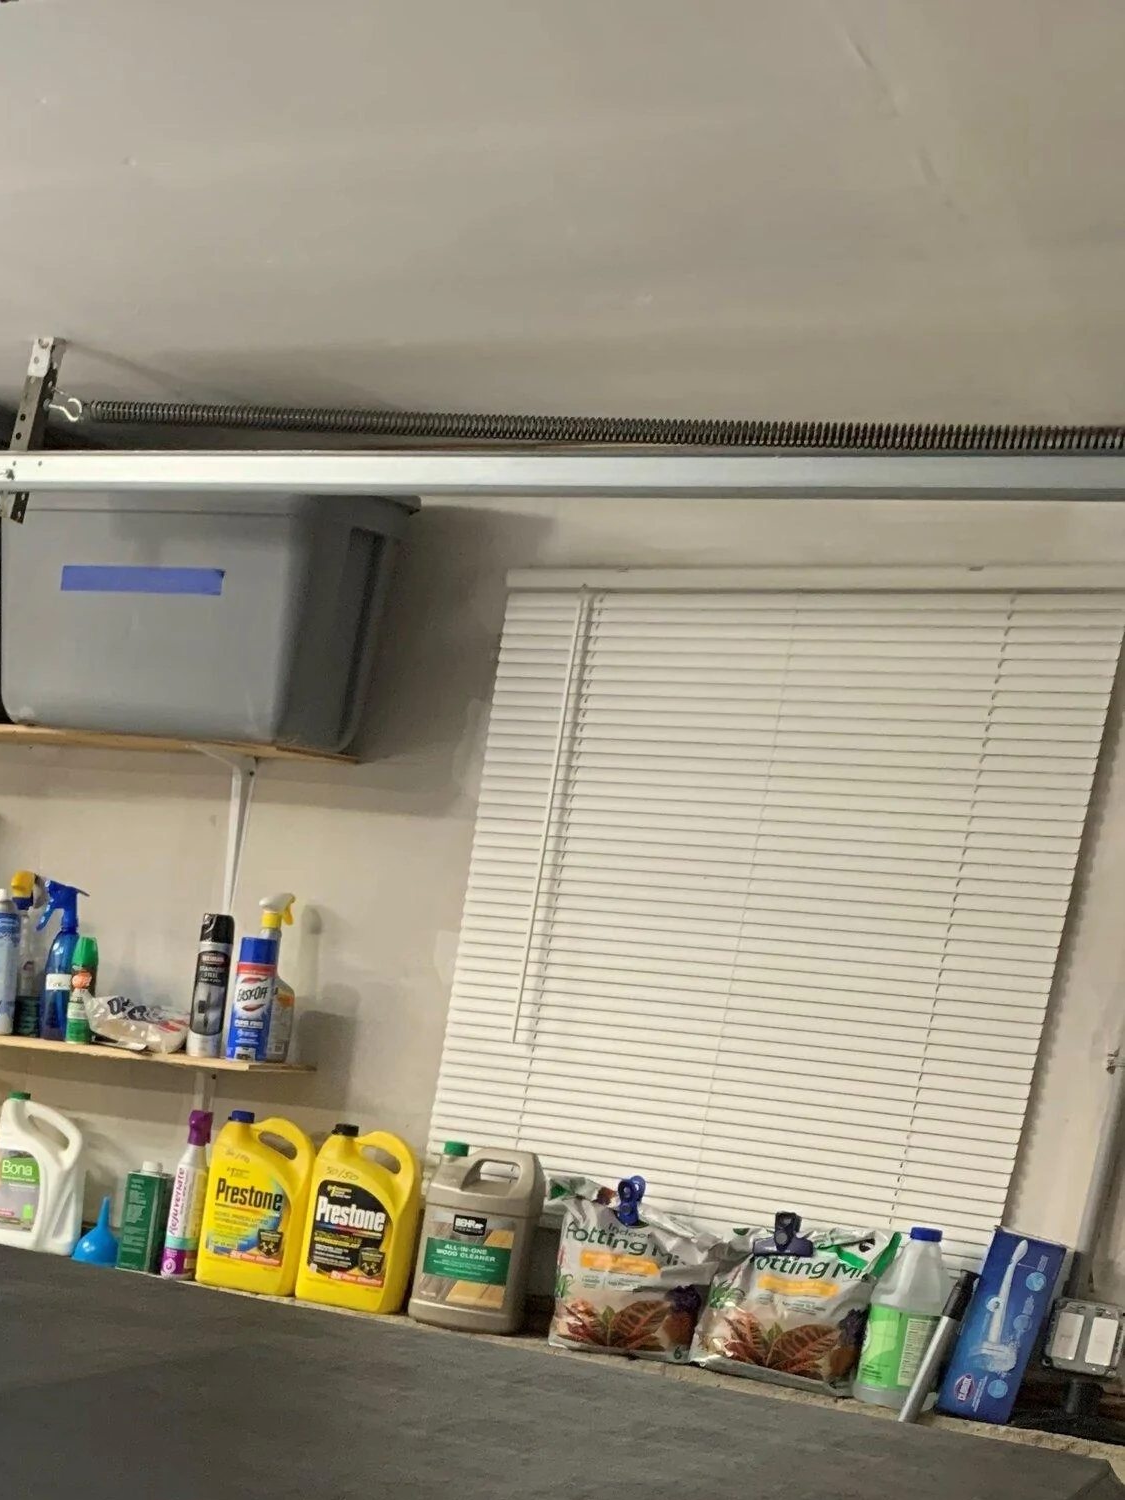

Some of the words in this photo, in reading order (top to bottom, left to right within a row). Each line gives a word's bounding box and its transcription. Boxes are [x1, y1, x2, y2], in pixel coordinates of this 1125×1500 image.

[2, 1159, 32, 1176] Bona
[326, 1166, 359, 1180] 50/50
[168, 1167, 185, 1235] Rejuvenate
[215, 1177, 283, 1212] Prestone
[316, 1195, 386, 1232] Prestone
[455, 1217, 476, 1229] BEHR
[608, 1222, 652, 1240] Indoor
[436, 1248, 458, 1258] WOOD
[460, 1251, 496, 1263] CLEANER
[444, 1243, 488, 1255] ALL-IN-ONE
[755, 1255, 830, 1279] otting
[832, 1263, 863, 1279] Mi
[958, 1375, 973, 1401] CLOROX
